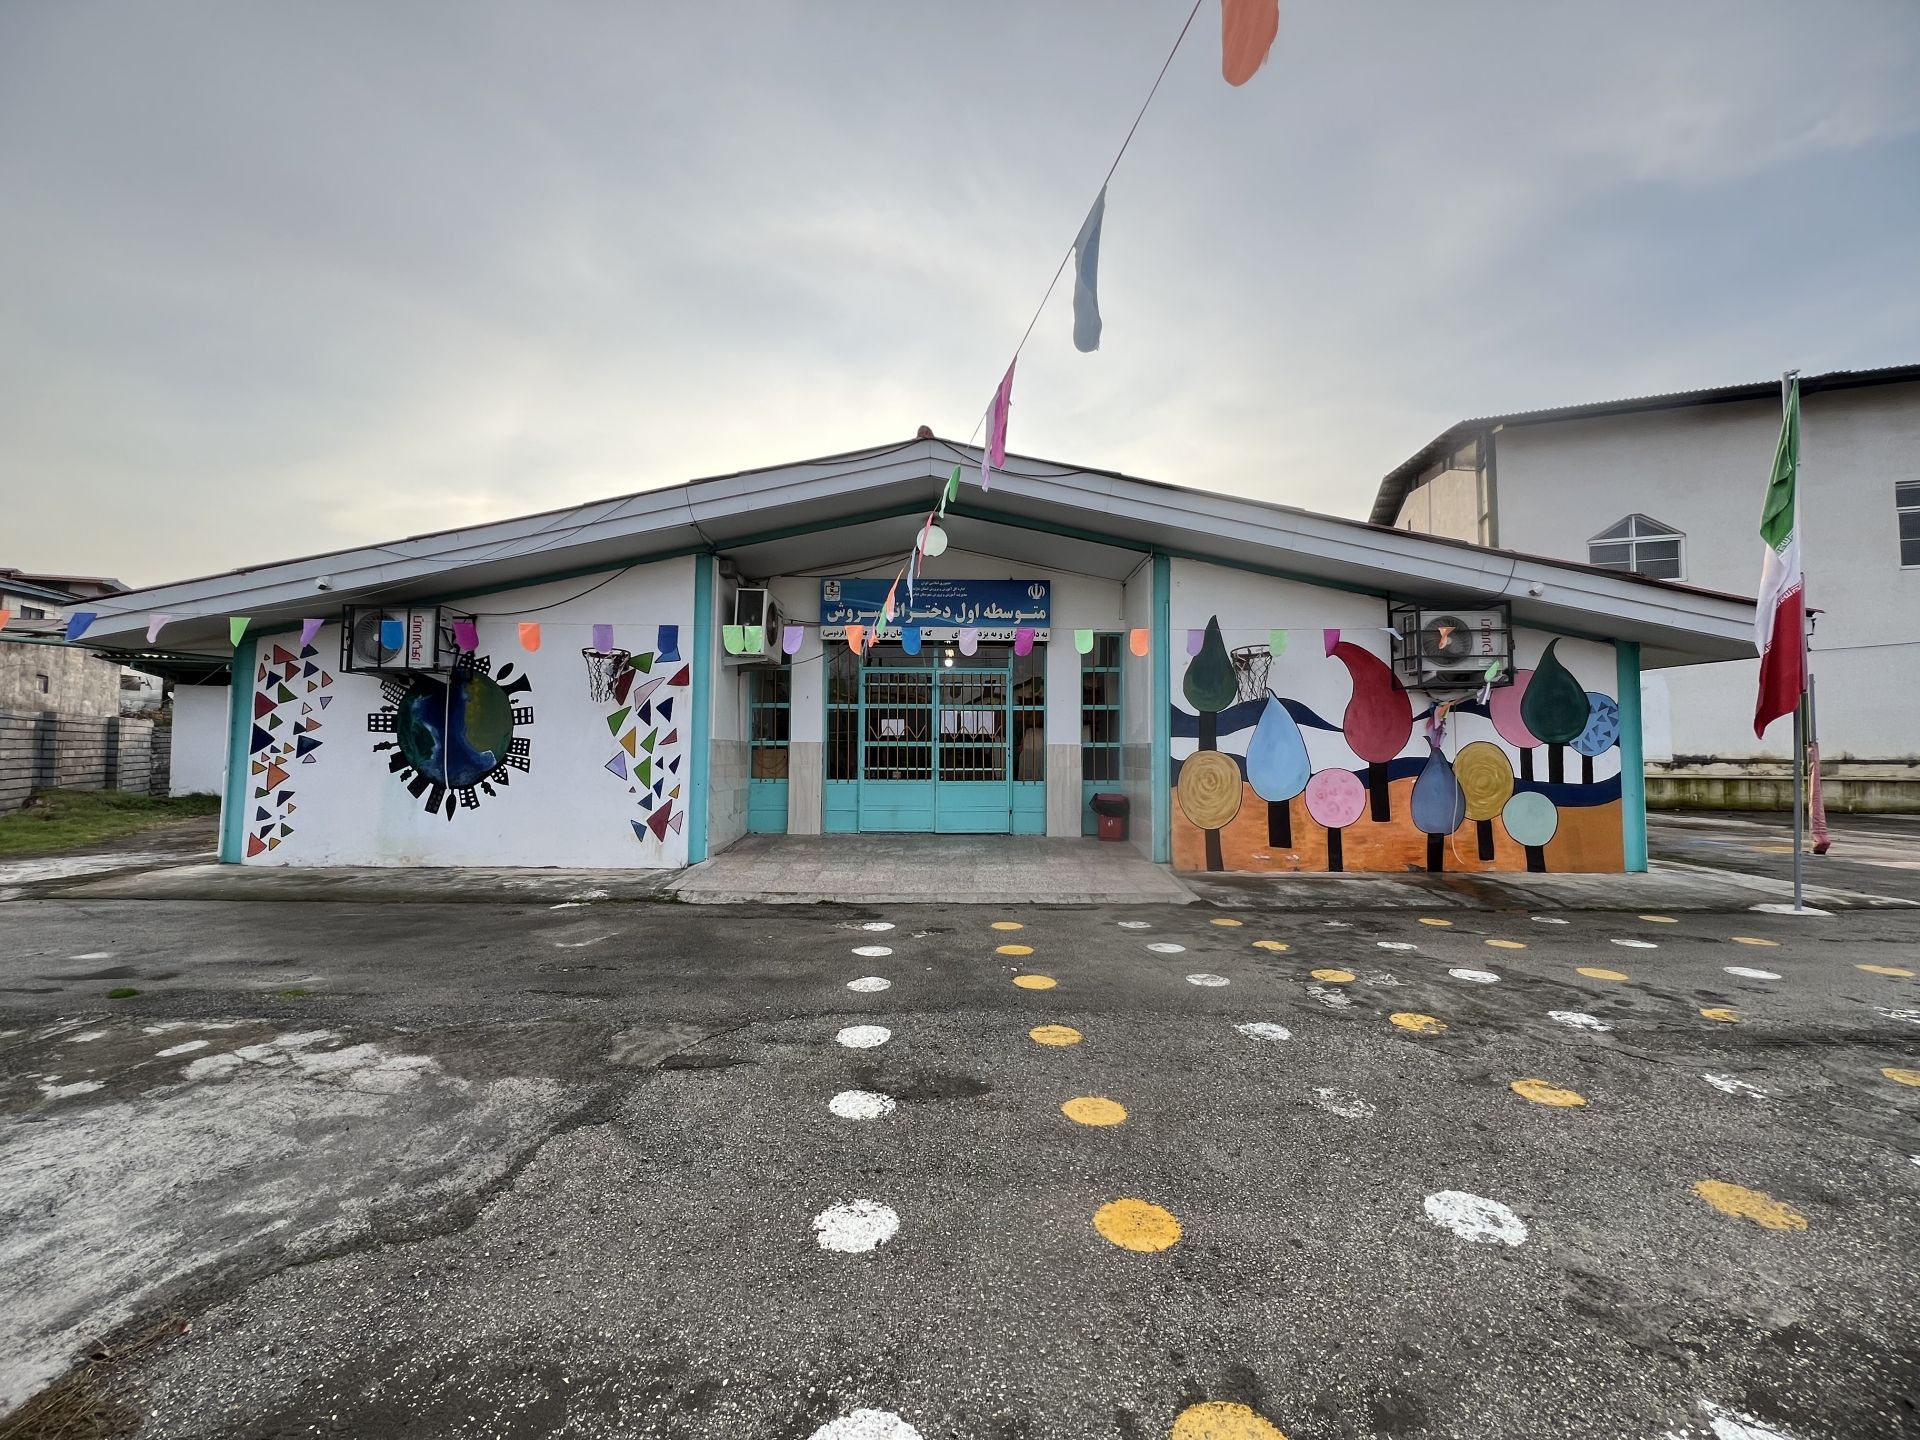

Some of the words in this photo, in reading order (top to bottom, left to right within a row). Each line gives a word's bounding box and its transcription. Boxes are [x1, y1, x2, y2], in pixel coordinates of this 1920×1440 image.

[893, 602, 951, 624] دختران
[954, 602, 980, 624] اول
[983, 602, 1046, 624] متوسطه
